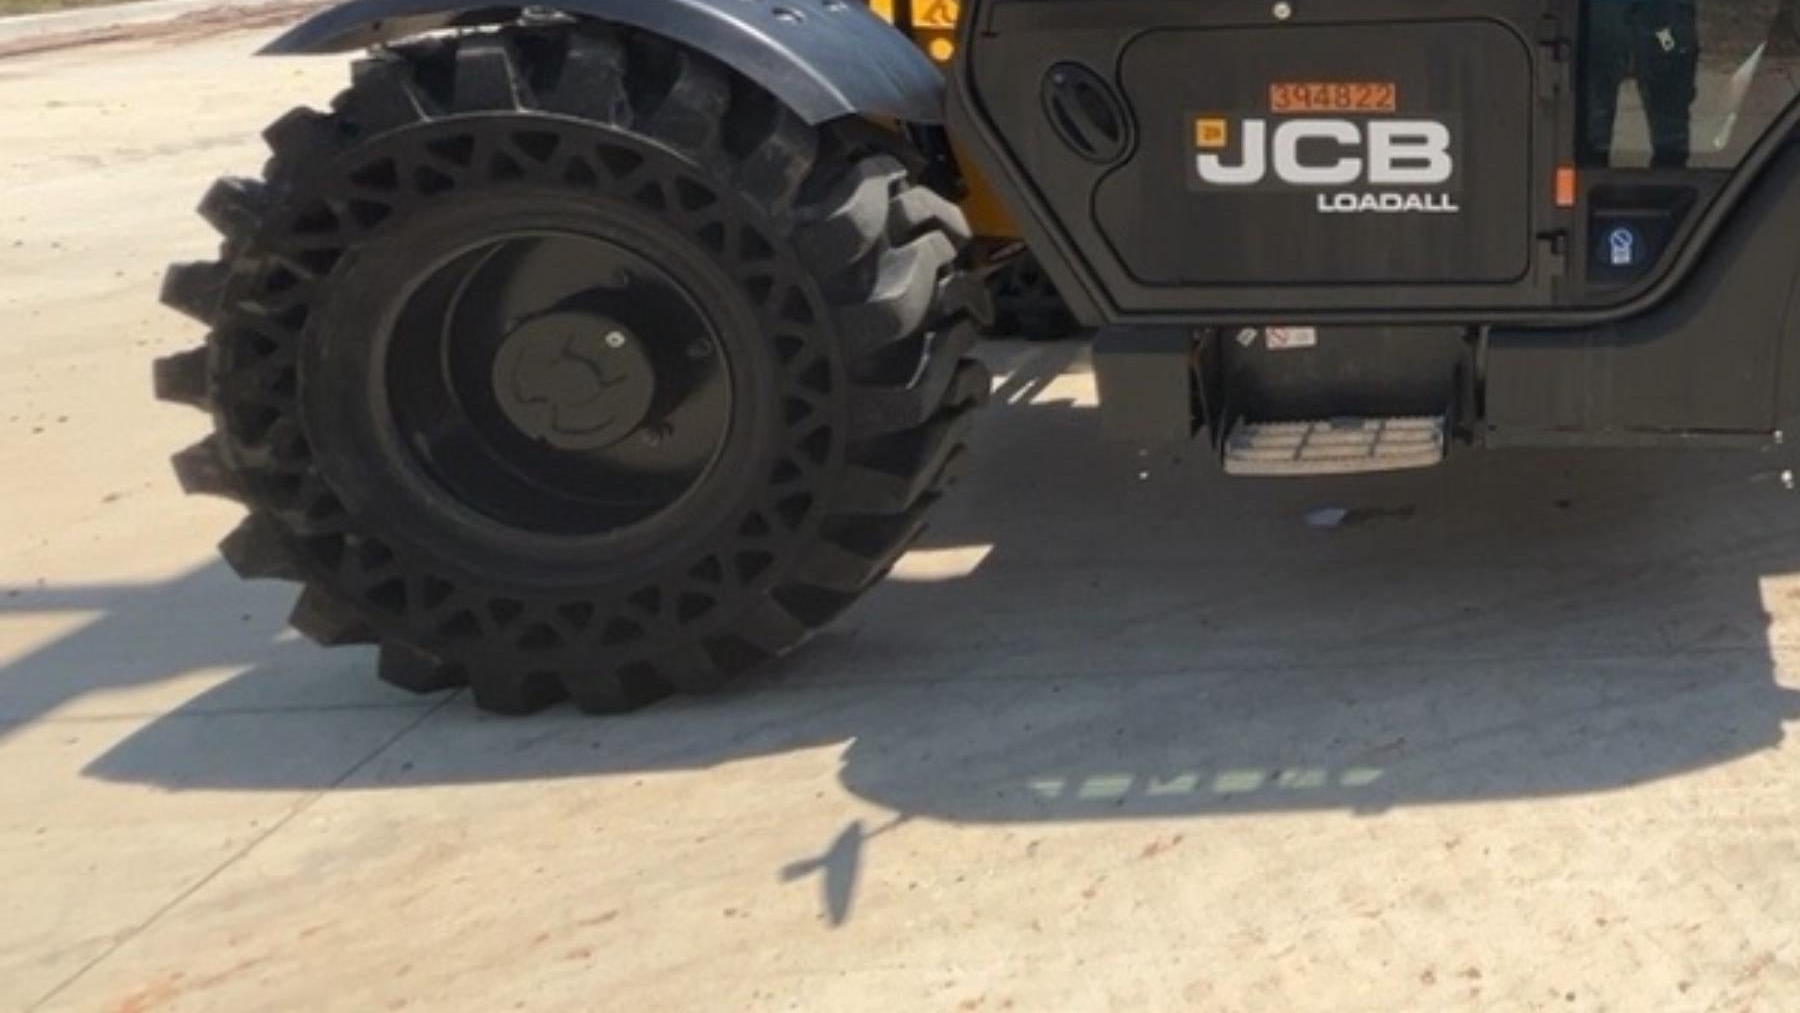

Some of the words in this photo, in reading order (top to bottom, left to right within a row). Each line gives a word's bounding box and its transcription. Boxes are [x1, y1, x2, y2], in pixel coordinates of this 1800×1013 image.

[1273, 83, 1393, 109] 394822
[1196, 119, 1453, 184] JCB
[1316, 193, 1460, 213] LOADALL
